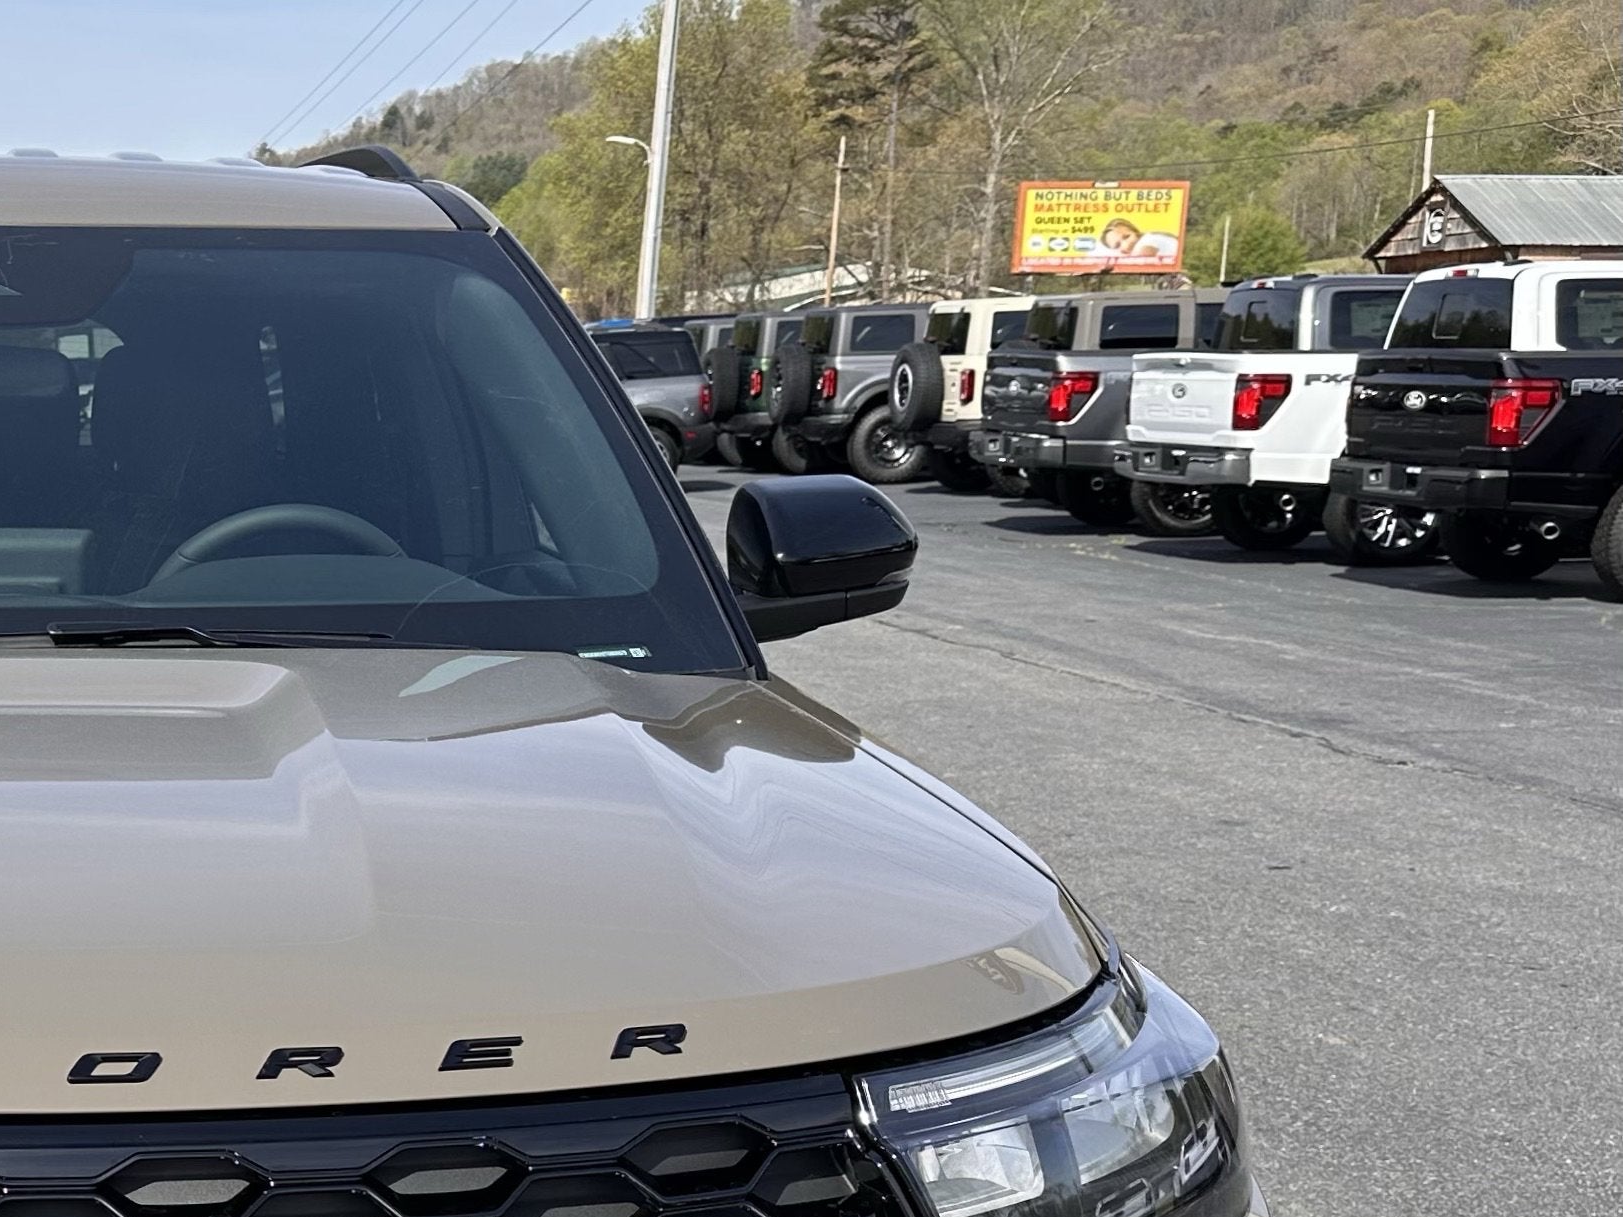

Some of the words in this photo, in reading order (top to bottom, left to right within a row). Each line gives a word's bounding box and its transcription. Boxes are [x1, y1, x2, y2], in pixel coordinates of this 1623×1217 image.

[1035, 191, 1098, 201] NOTHING
[1104, 191, 1131, 201] BUT
[1137, 190, 1173, 201] BEDS
[1034, 202, 1109, 213] MATTRESS
[1114, 202, 1171, 213] OUTLET
[1035, 216, 1070, 225] QUEEN
[1073, 216, 1092, 225] SET
